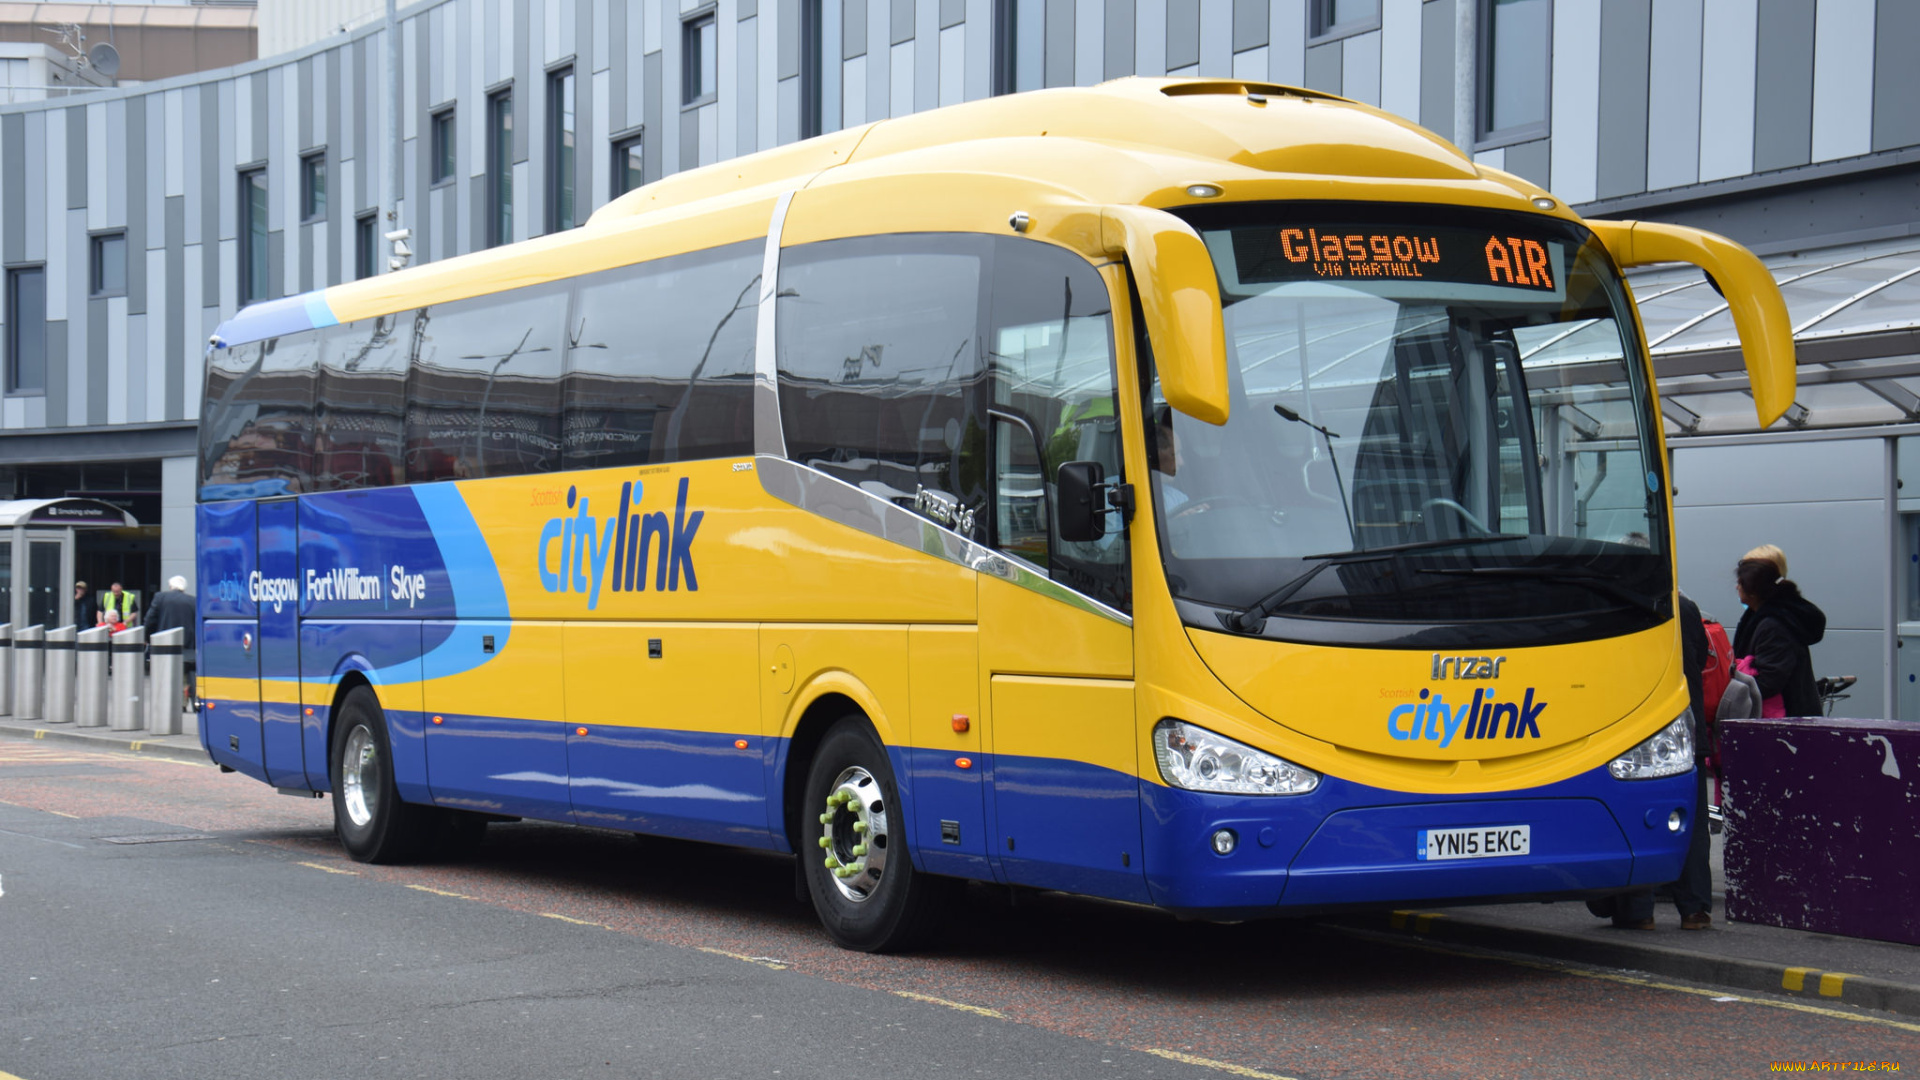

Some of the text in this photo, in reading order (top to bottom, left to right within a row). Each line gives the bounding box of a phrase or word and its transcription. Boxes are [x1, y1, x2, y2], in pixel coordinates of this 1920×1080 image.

[1280, 228, 1553, 289] Glasgow AIR
[1313, 262, 1423, 277] VIA HARTHILL
[914, 483, 957, 524] Irizar
[538, 477, 705, 610] citylink
[249, 570, 298, 613] Glasgow
[306, 568, 332, 600] Fort
[332, 567, 380, 600] William
[390, 564, 426, 609] Skye
[1431, 653, 1507, 680] Irizar
[1379, 688, 1415, 699] Scottish
[1387, 687, 1548, 748] citylink
[1434, 830, 1522, 856] YN15 EKC
